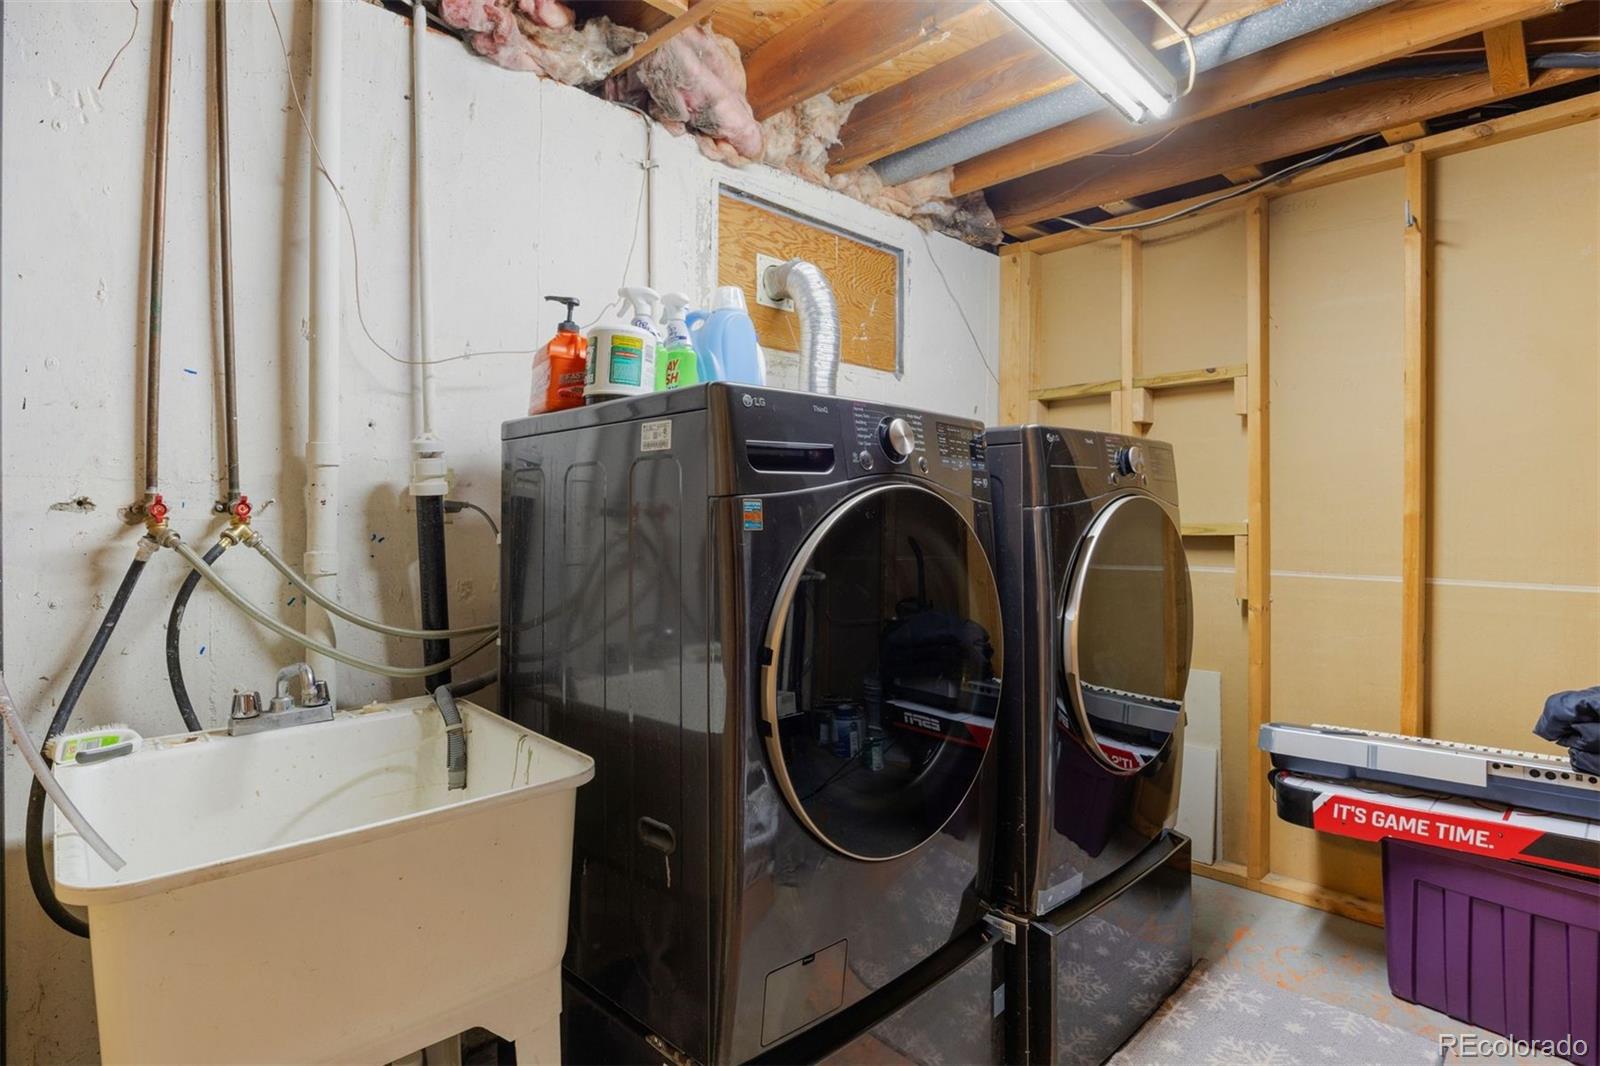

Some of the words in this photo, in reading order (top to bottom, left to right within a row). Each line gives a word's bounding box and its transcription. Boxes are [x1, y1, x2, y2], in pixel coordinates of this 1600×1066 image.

[1332, 802, 1367, 825] IT'S
[1371, 810, 1430, 837] GAME
[1435, 821, 1495, 849] TIME.
